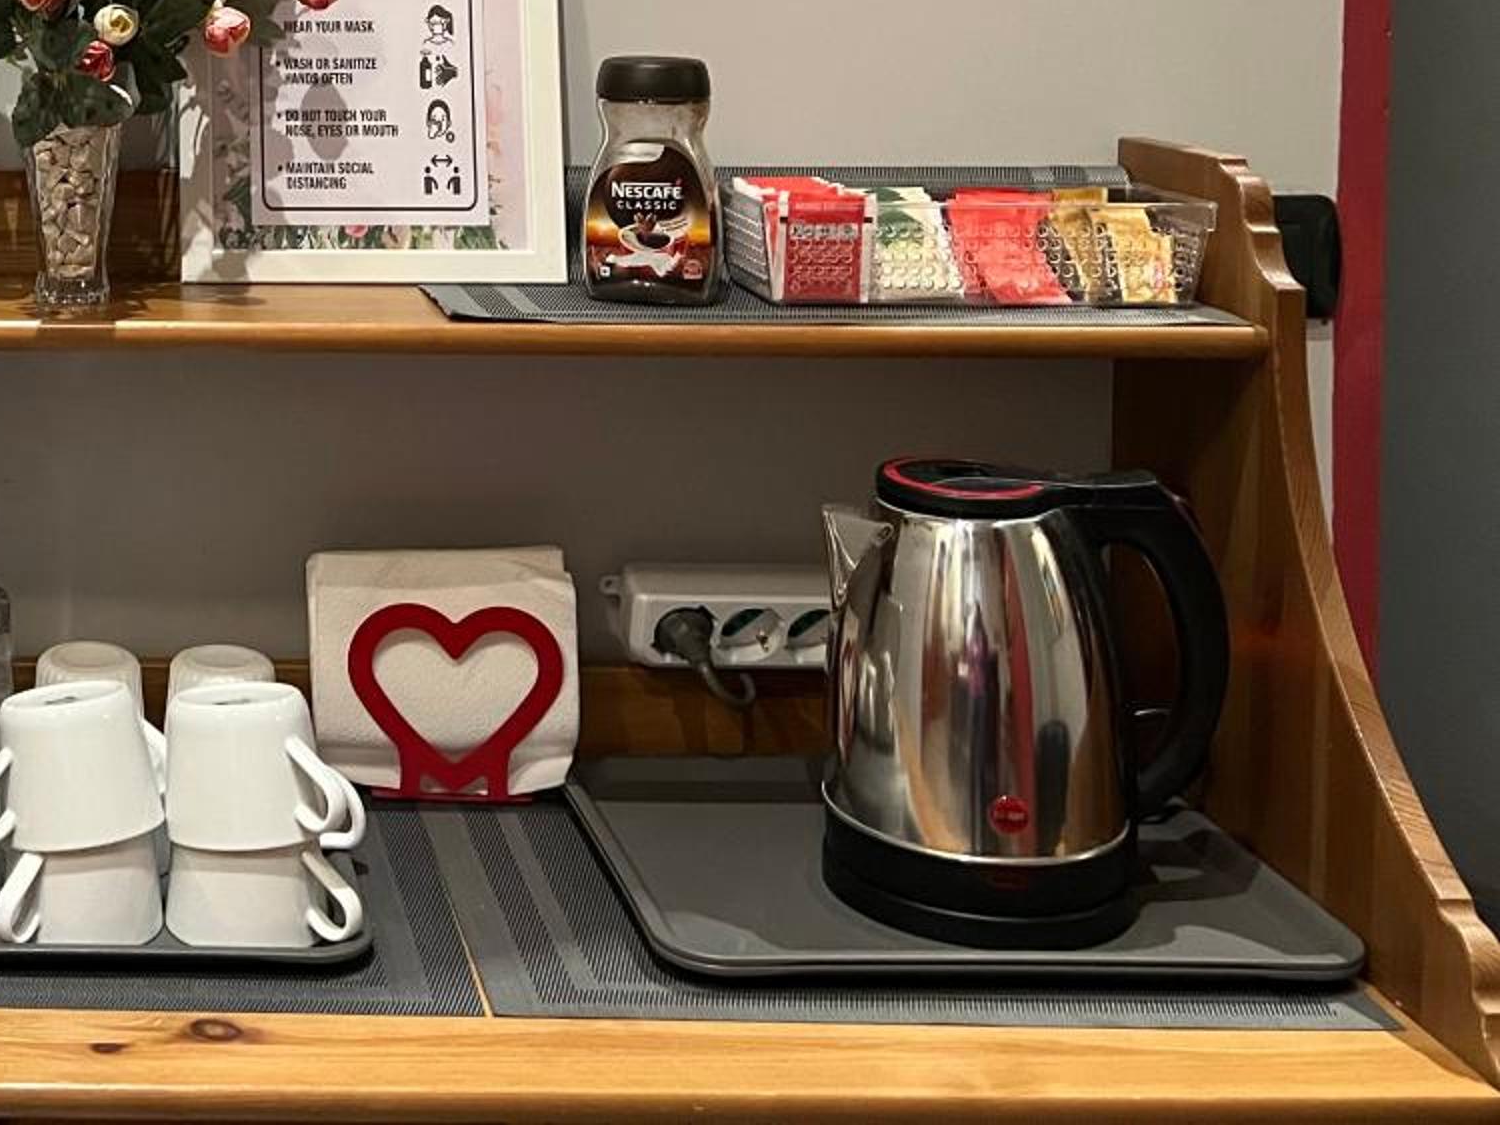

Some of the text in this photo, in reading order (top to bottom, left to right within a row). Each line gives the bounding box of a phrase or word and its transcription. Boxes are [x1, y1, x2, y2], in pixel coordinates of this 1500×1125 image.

[316, 20, 341, 33] YOUR
[344, 20, 375, 33] MASK
[283, 58, 378, 70] WASH OR SANITIZE
[321, 73, 353, 85] OFTEN
[325, 109, 357, 122] TOUCH
[360, 109, 387, 122] YOUR
[318, 124, 343, 137] EYES
[362, 124, 399, 137] MOUTH
[285, 162, 375, 174] MAINTAIN SOCIAL
[616, 200, 677, 210] CLASSIC
